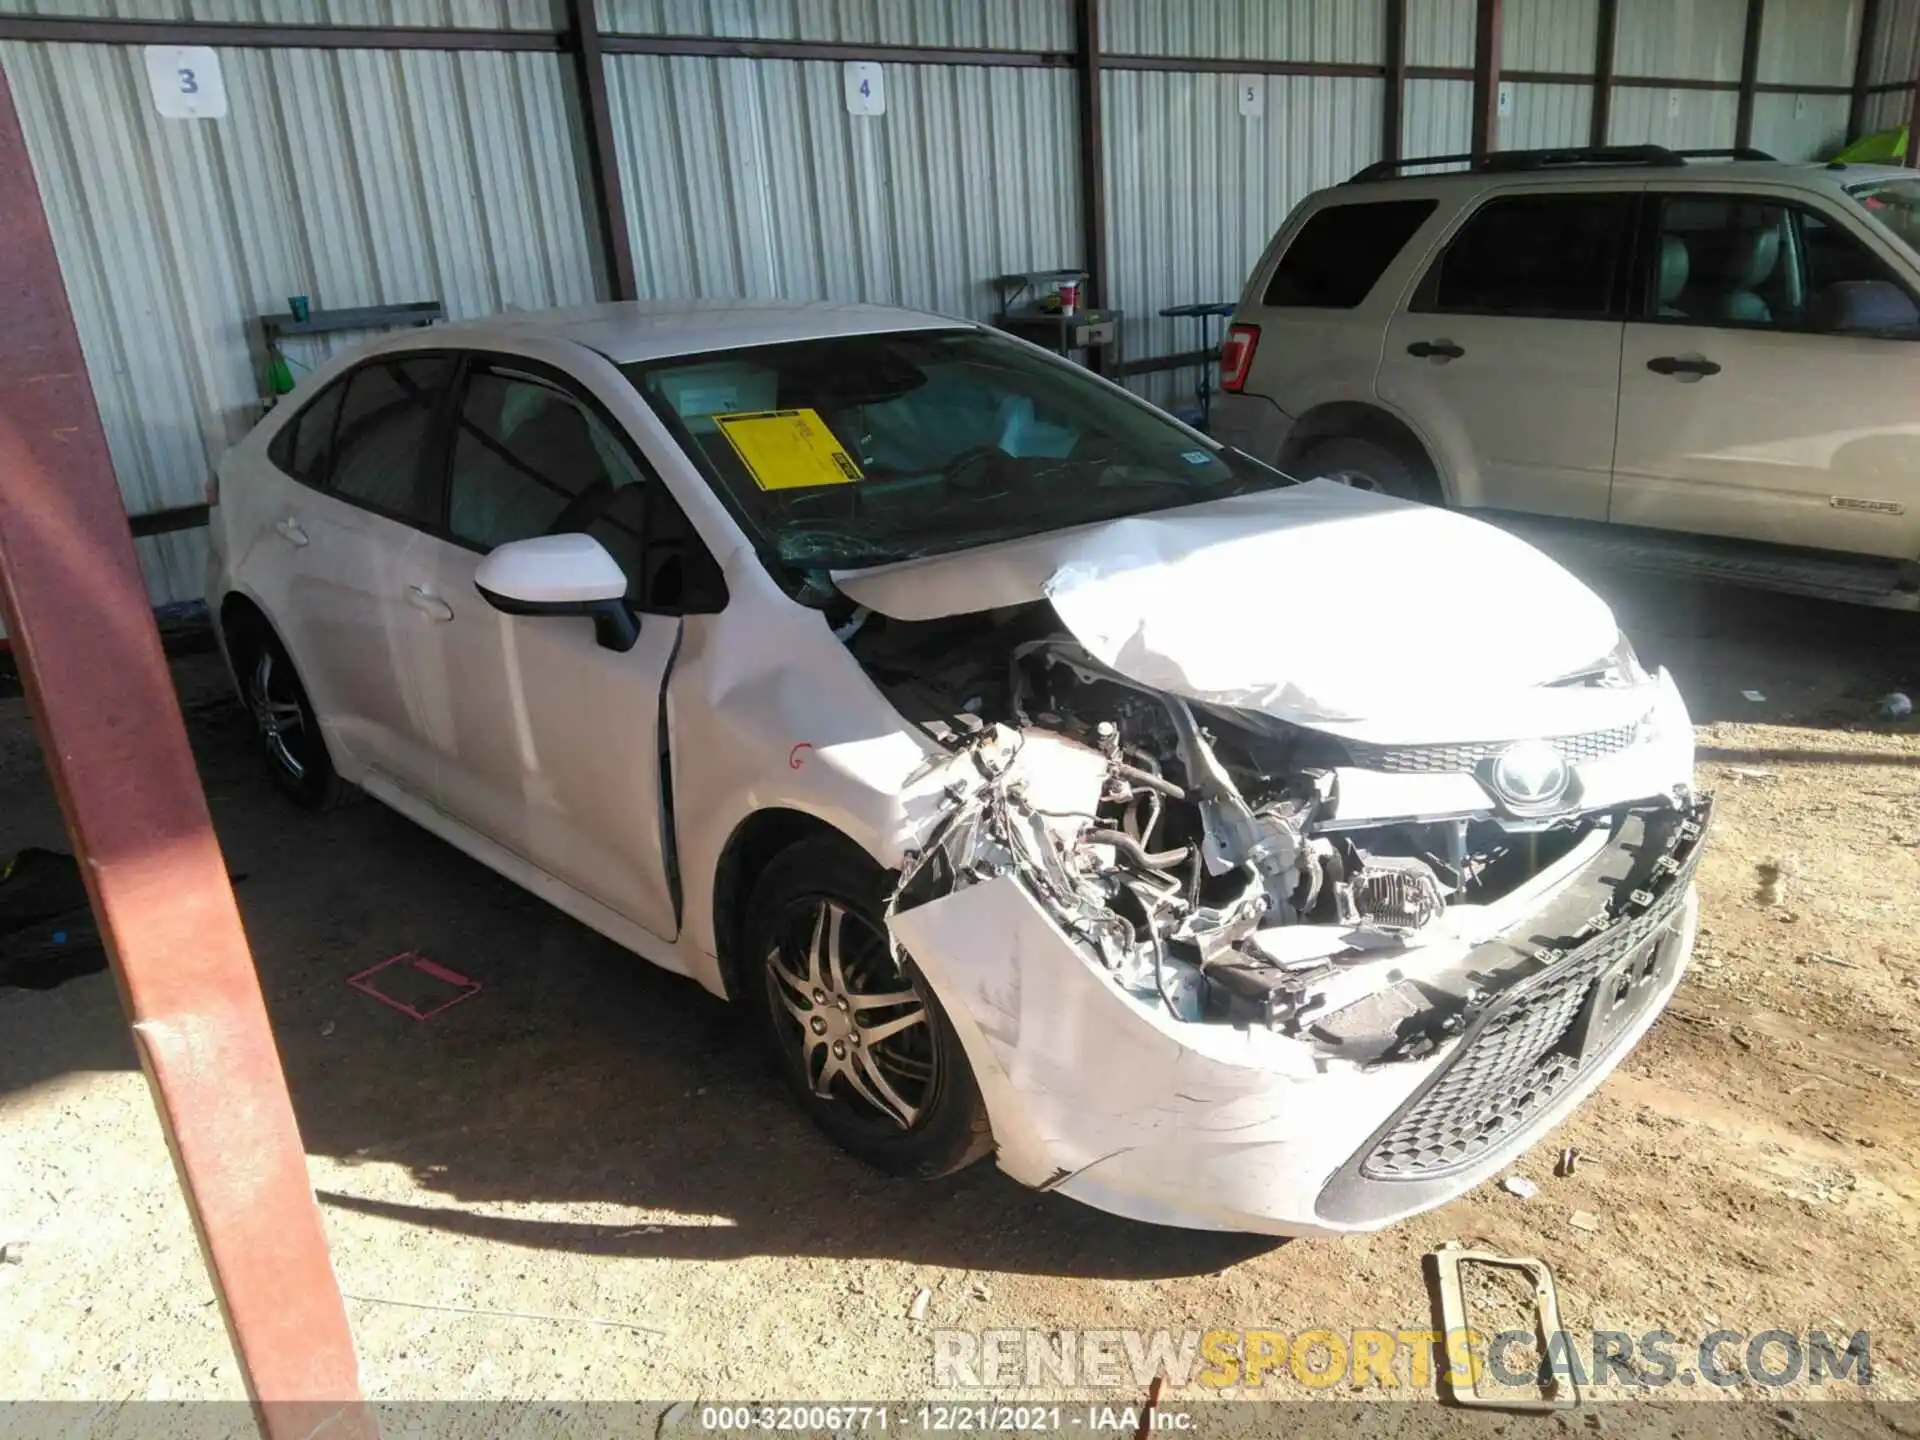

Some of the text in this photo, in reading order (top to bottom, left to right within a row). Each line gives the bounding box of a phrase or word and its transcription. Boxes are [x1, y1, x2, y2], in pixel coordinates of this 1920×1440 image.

[178, 68, 198, 94] 3
[860, 79, 870, 98] 4
[1247, 86, 1255, 102] 5
